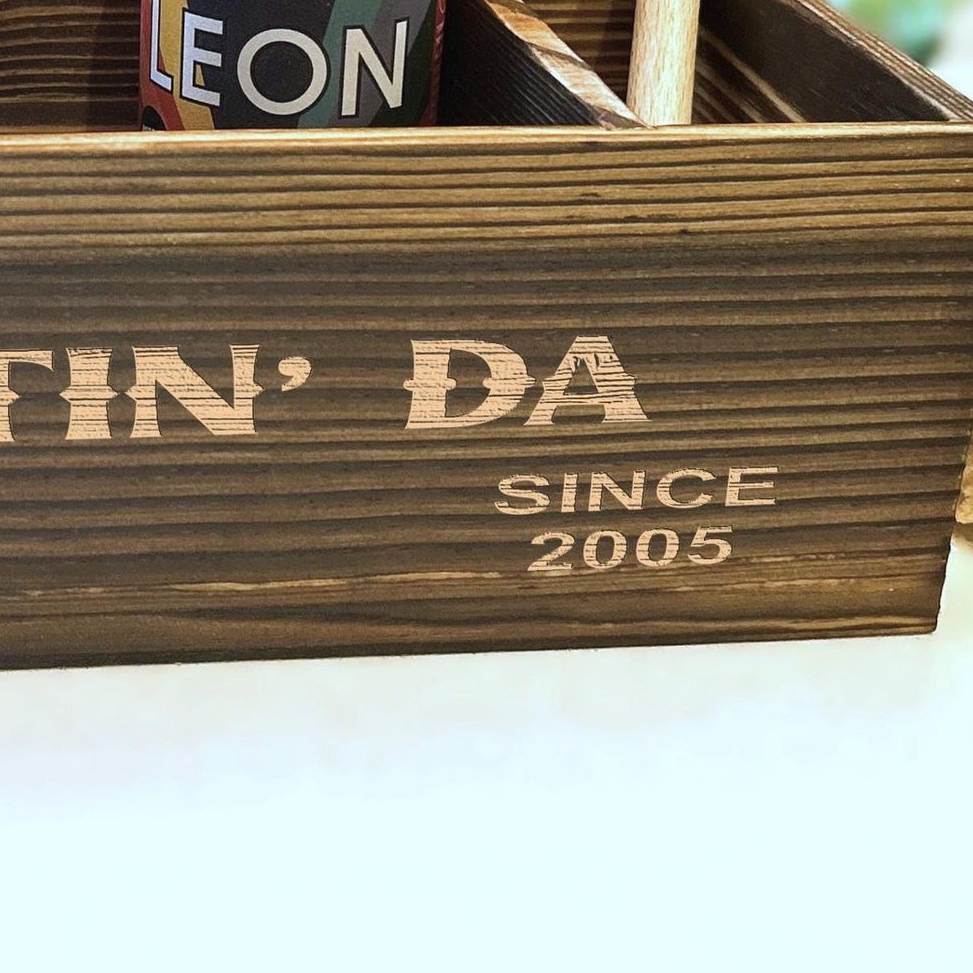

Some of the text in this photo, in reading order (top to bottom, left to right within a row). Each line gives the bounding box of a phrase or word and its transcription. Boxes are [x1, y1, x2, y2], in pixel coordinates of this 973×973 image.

[403, 335, 651, 429] DA
[494, 466, 779, 515] SINCE
[527, 525, 733, 572] 2005
